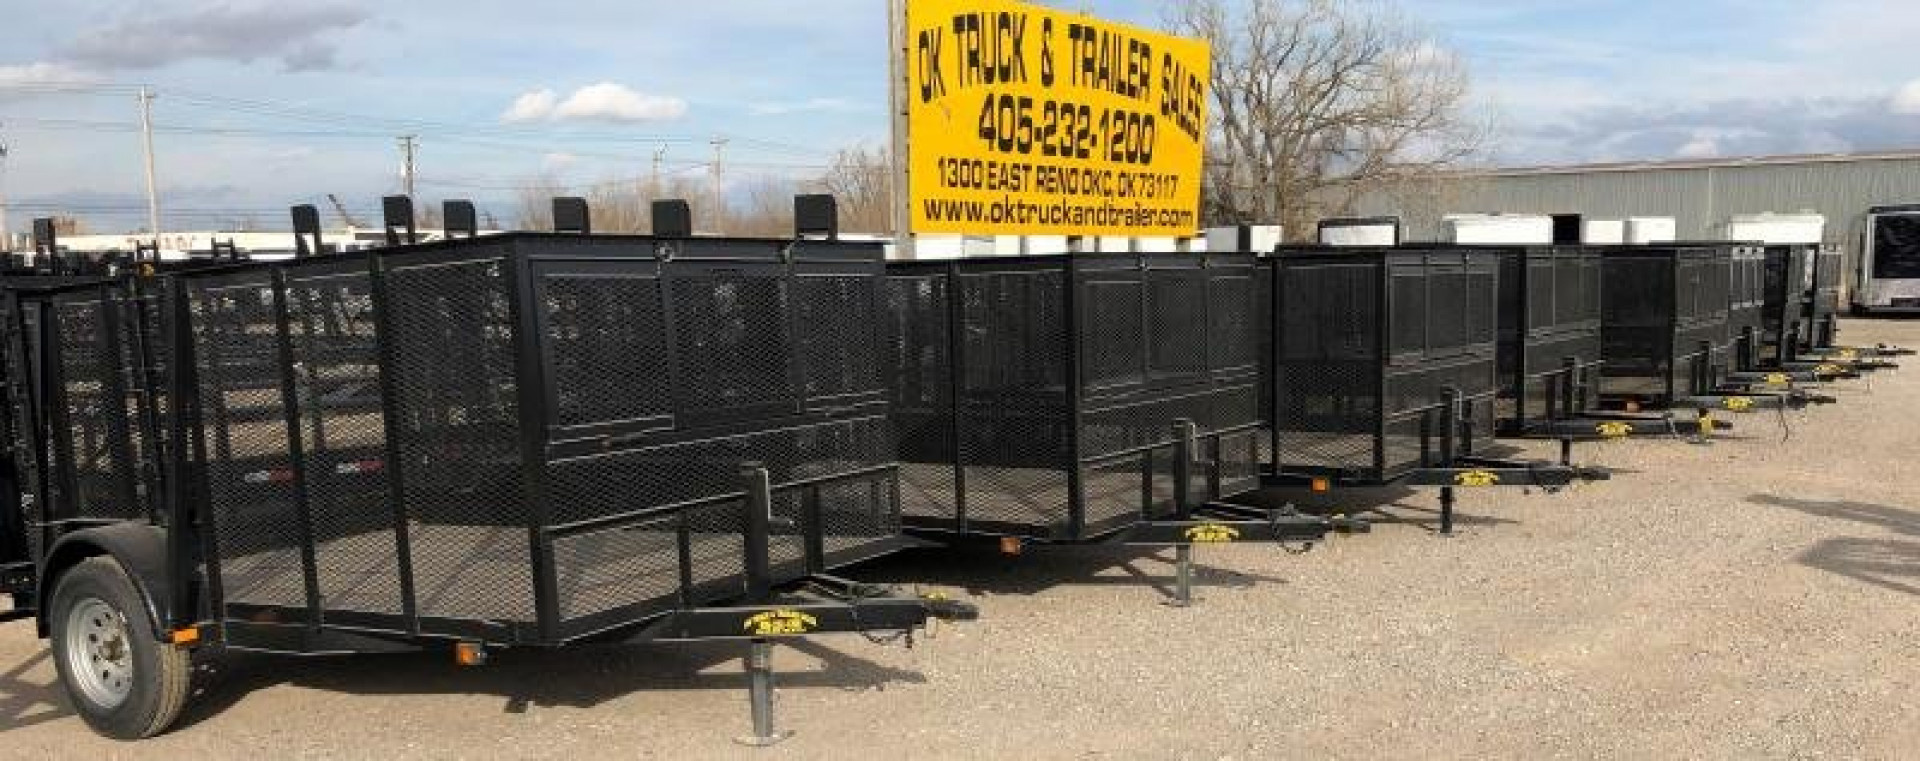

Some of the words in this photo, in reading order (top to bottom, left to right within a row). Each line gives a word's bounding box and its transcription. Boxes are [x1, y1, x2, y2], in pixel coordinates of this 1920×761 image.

[919, 27, 946, 103] OK
[953, 12, 1028, 88] TRUCK
[1041, 17, 1055, 87] &
[1068, 23, 1152, 102] TRAILER
[1161, 52, 1204, 144] SALES
[978, 93, 1154, 166] 405-232-1200
[938, 157, 983, 188] 1300
[988, 162, 1032, 193] EAST
[1036, 165, 1079, 196] RENO
[1117, 173, 1138, 198] OK
[1139, 174, 1179, 200] 73117
[923, 195, 1193, 229] www.oktruckandtrailer.com
